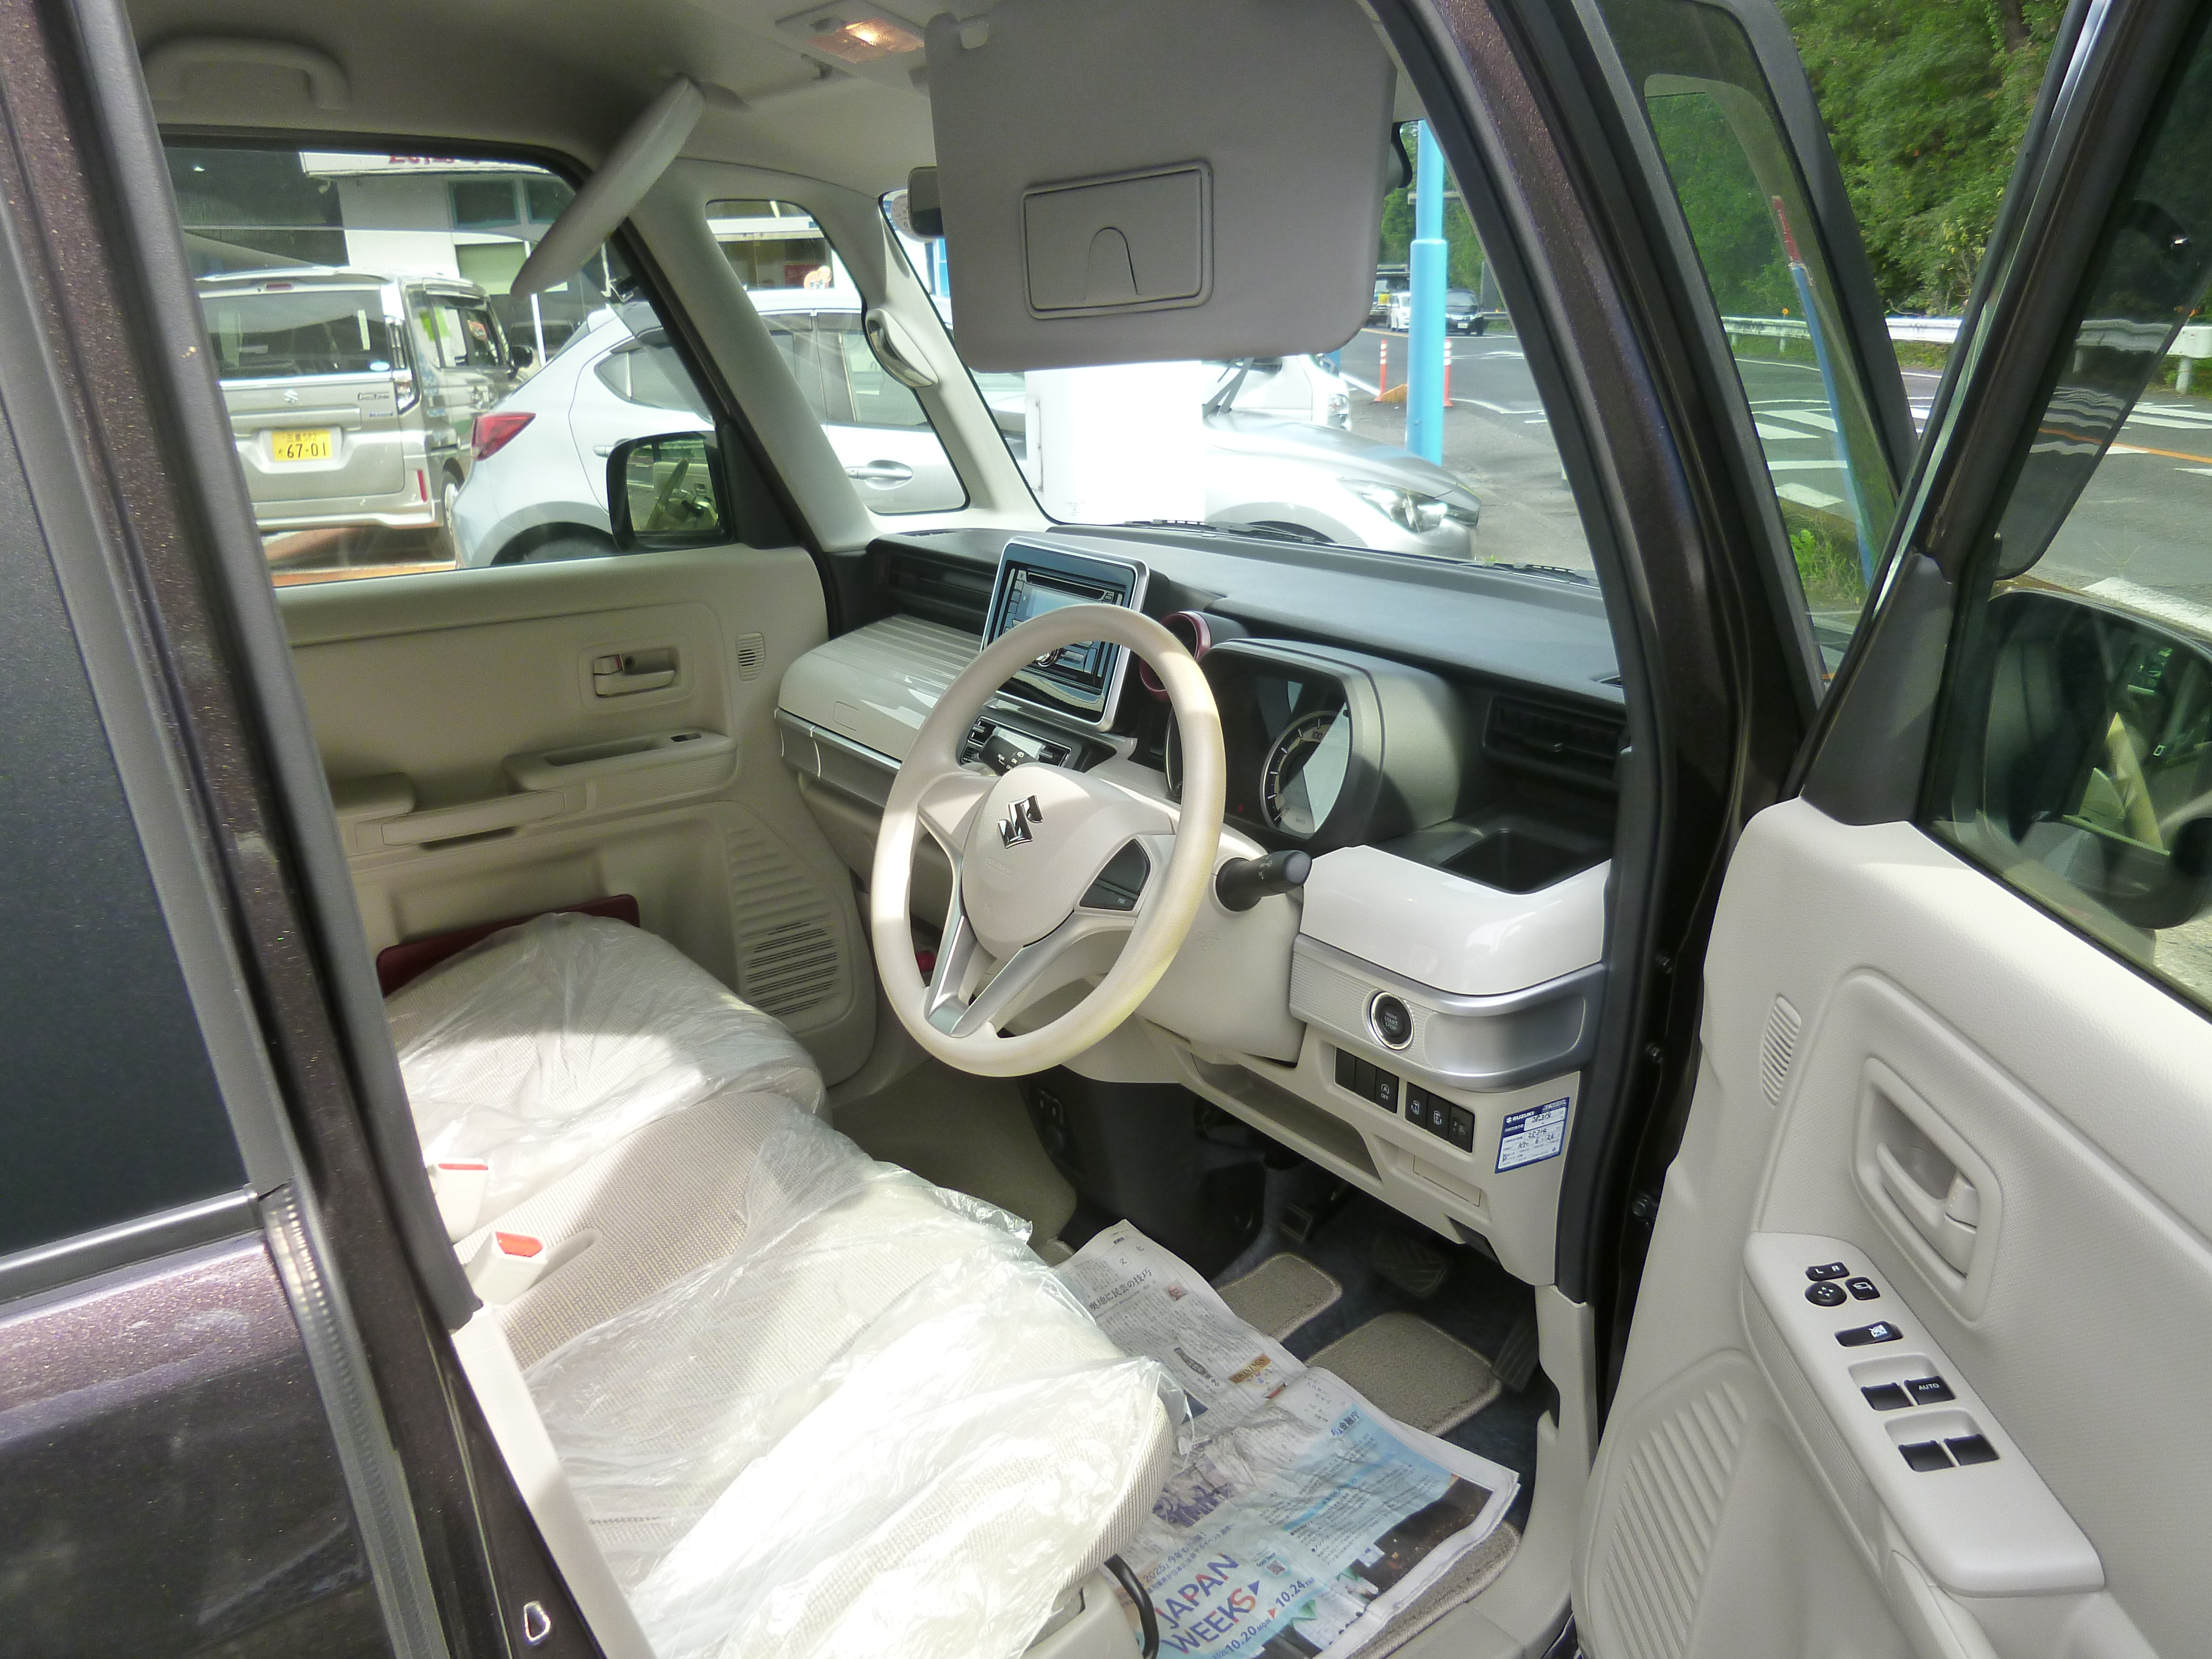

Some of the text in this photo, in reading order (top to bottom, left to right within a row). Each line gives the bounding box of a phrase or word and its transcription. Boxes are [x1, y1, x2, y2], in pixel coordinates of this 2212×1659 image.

[287, 442, 326, 458] 67-01
[1384, 1016, 1398, 1026] START
[1385, 1022, 1397, 1030] STOP
[1512, 1111, 1535, 1121] SUZUKI
[1233, 1357, 1265, 1380] TWININGS
[1154, 1552, 1239, 1629] JAPAN
[1161, 1587, 1256, 1655] WEEKS
[1225, 1626, 1257, 1652] 10.20
[1256, 1618, 1272, 1632] MON
[1275, 1580, 1306, 1608] 10.24
[1305, 1577, 1316, 1587] FRI
